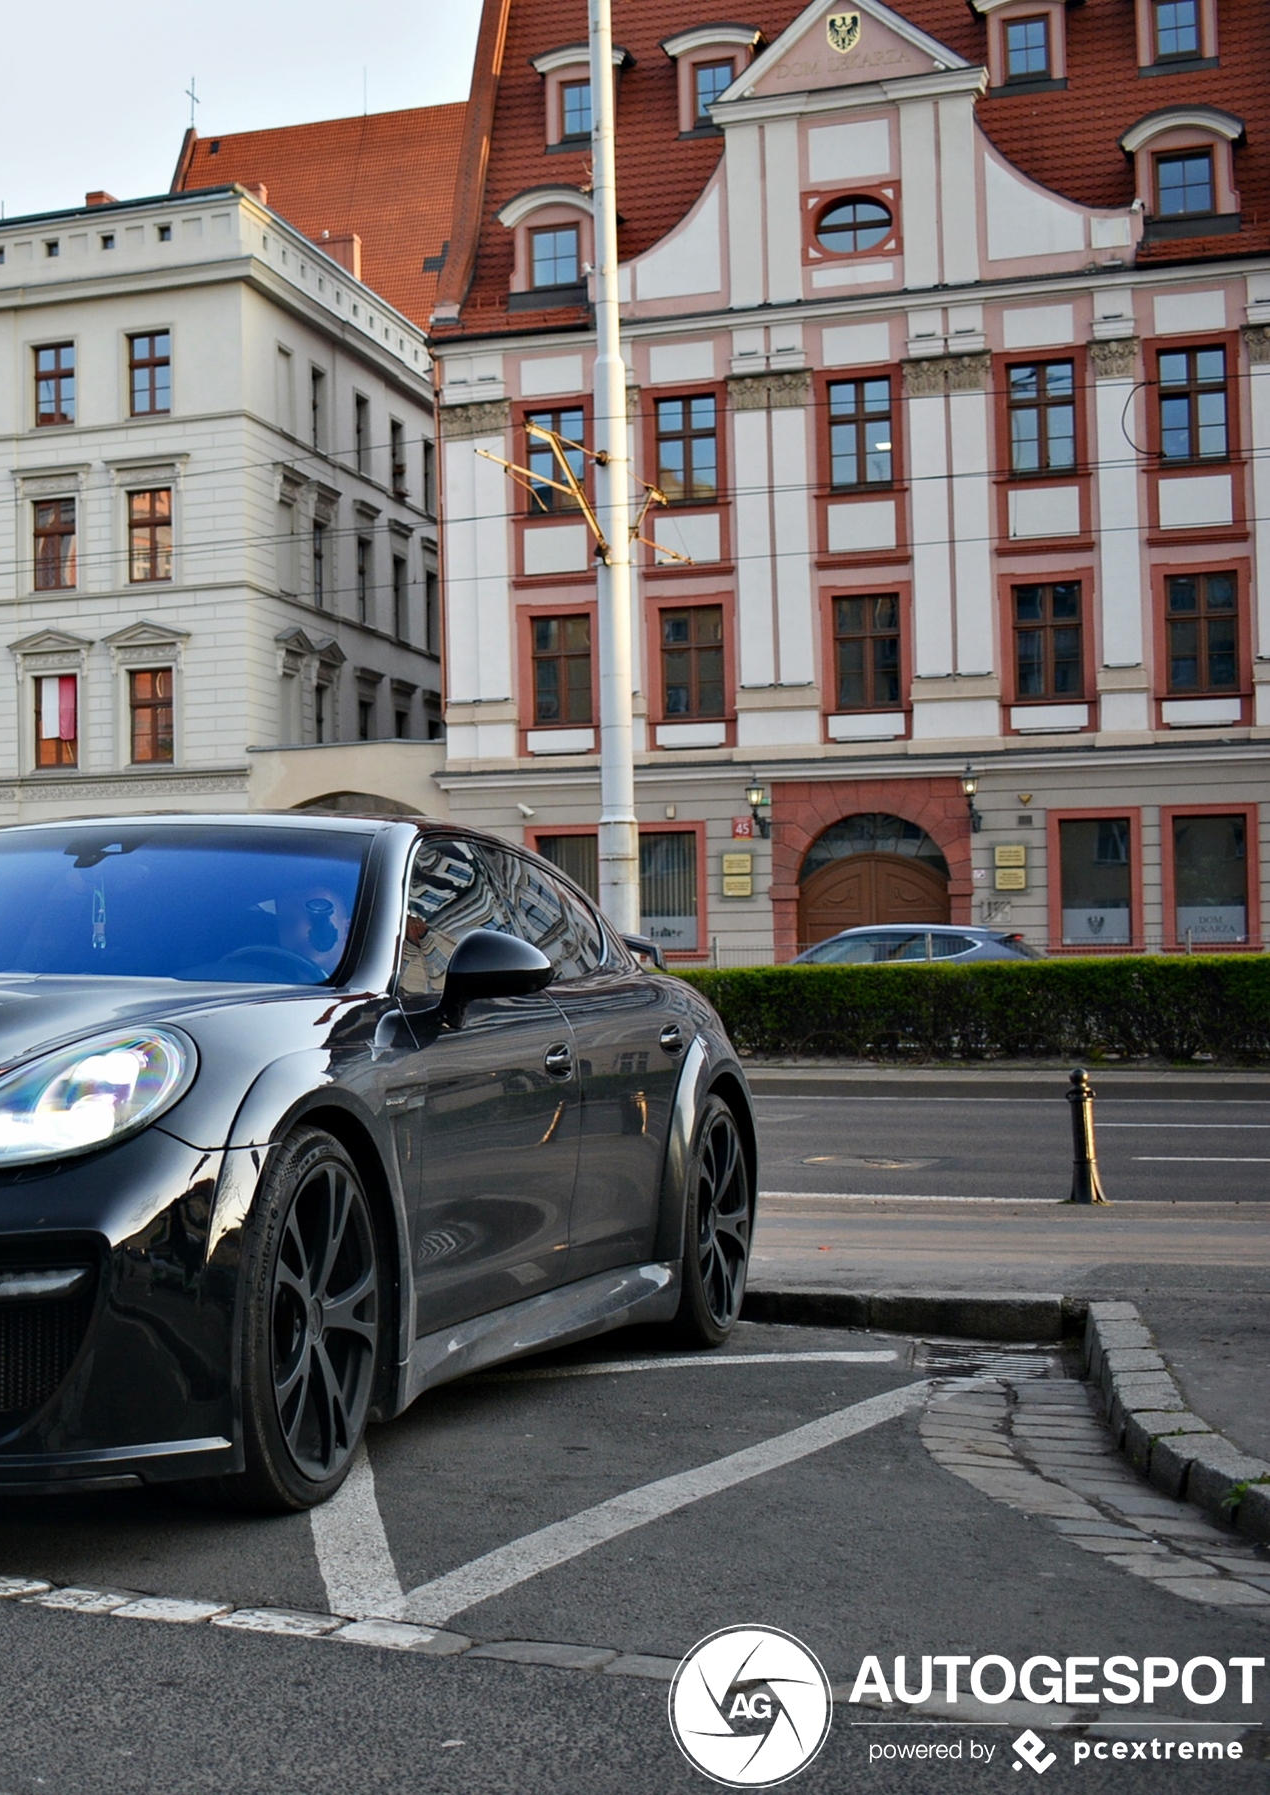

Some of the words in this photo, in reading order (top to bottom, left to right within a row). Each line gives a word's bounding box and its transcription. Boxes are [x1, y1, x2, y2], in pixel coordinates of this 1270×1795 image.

[776, 61, 820, 79] DOM
[827, 50, 911, 73] LEKARZA
[735, 823, 750, 835] 45
[1199, 916, 1223, 924] DOM
